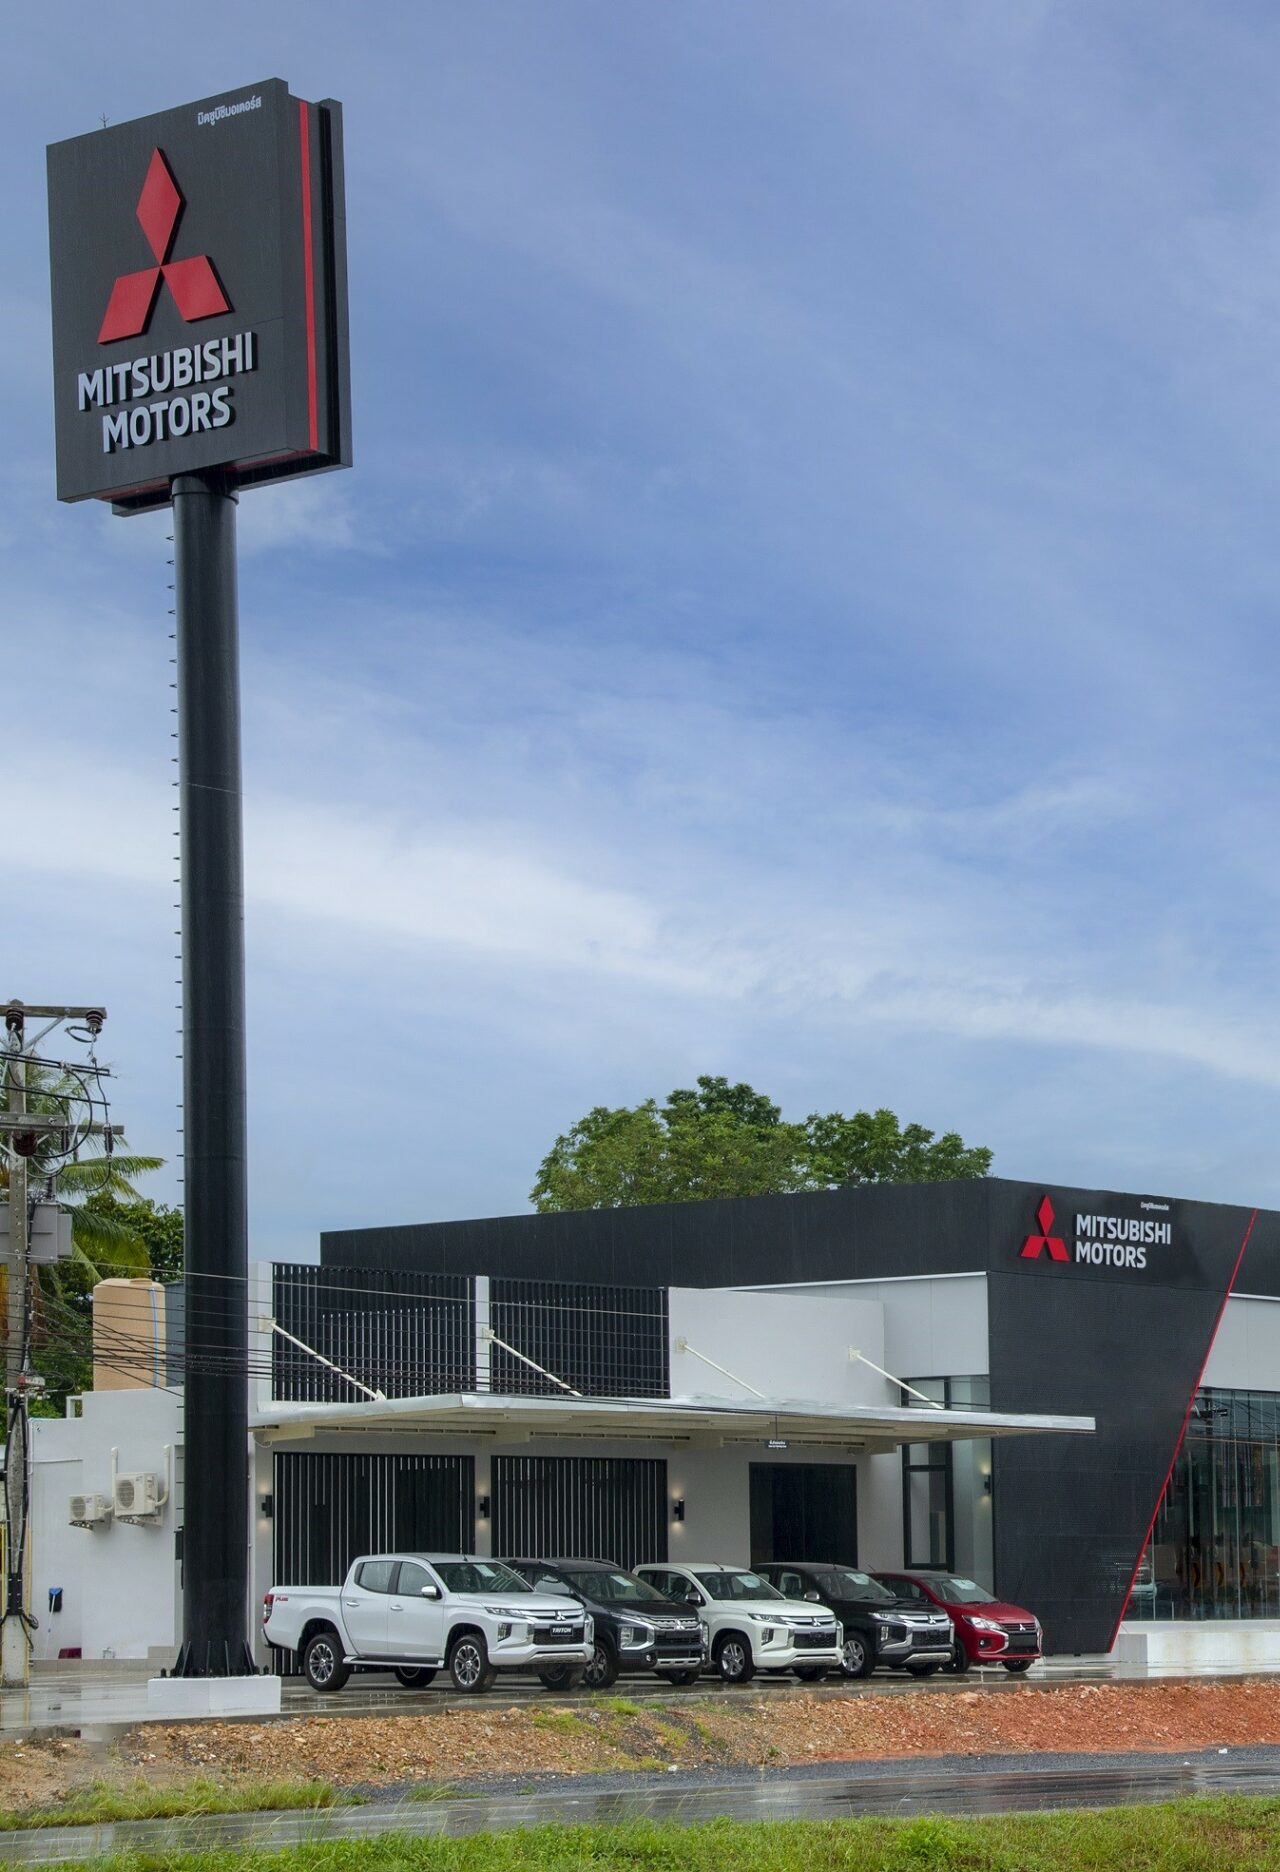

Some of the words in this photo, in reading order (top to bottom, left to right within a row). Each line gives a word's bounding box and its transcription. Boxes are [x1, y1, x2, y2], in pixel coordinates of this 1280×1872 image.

[78, 331, 253, 411] MITSUBISHI
[102, 386, 231, 453] MOTORS
[1076, 1214, 1171, 1244] MITSUBISHI
[1076, 1241, 1147, 1268] MOTORS
